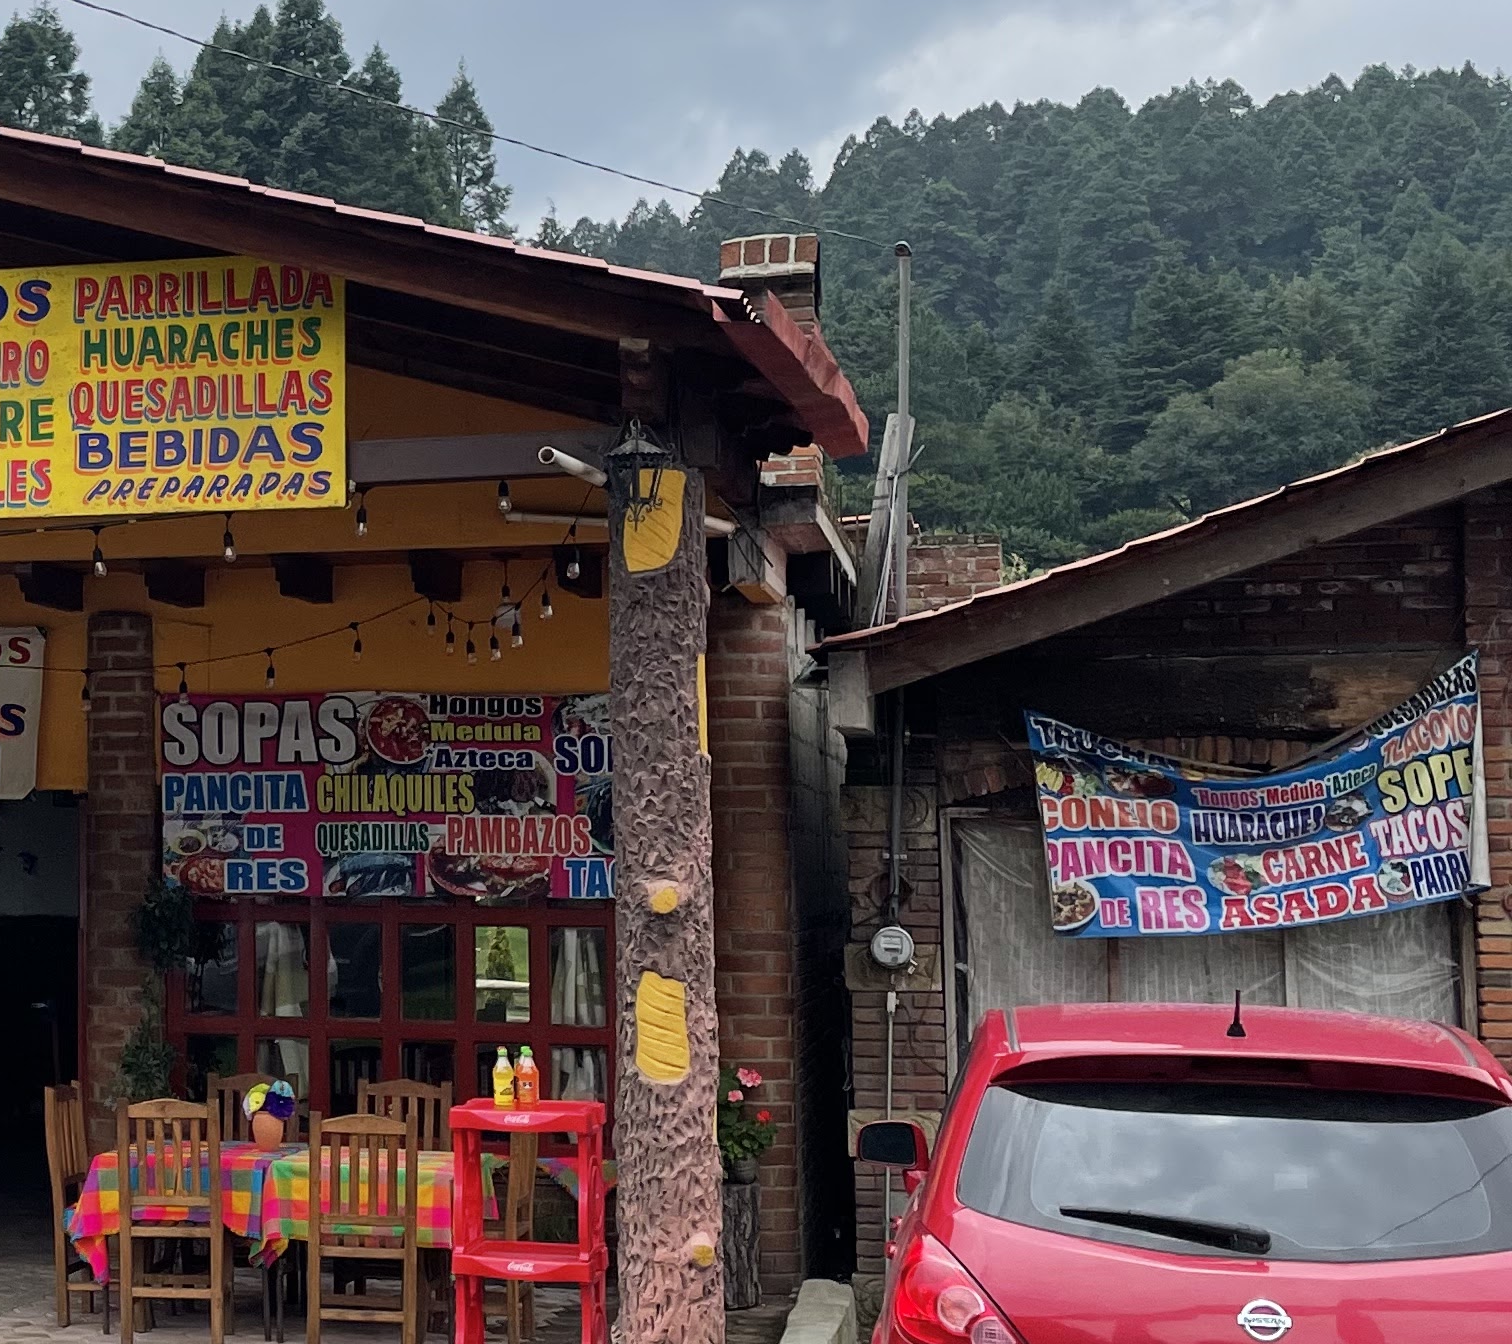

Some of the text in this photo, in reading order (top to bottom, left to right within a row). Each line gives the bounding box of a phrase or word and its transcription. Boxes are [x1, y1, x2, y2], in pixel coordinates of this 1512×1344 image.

[72, 263, 335, 324] PARRILLADA
[78, 315, 325, 375] HUARACHES
[68, 368, 335, 431] QUESADILLAS
[74, 421, 326, 475] BEBIDAS
[82, 470, 333, 506] PREPARADAS
[428, 693, 545, 719] Hongos
[162, 696, 359, 767] SOPAS
[429, 722, 542, 743] Medula
[435, 748, 539, 772] Azteca
[553, 734, 614, 776] SO
[163, 771, 311, 814] PANCITA
[314, 772, 478, 817] CHILAQUILES
[1264, 780, 1326, 806] Medula
[1331, 763, 1377, 798] Azteca
[242, 823, 285, 853] DE
[315, 821, 431, 854] QUESADILLAS
[444, 814, 593, 857] PAMBAZOS
[1190, 805, 1326, 846] HUARACHES
[1370, 799, 1470, 859] TACOS
[224, 857, 309, 895] RES
[563, 857, 615, 899] TA
[1261, 832, 1368, 886] CARNE
[1099, 887, 1211, 934] DE RES
[1219, 874, 1387, 931] ASADA
